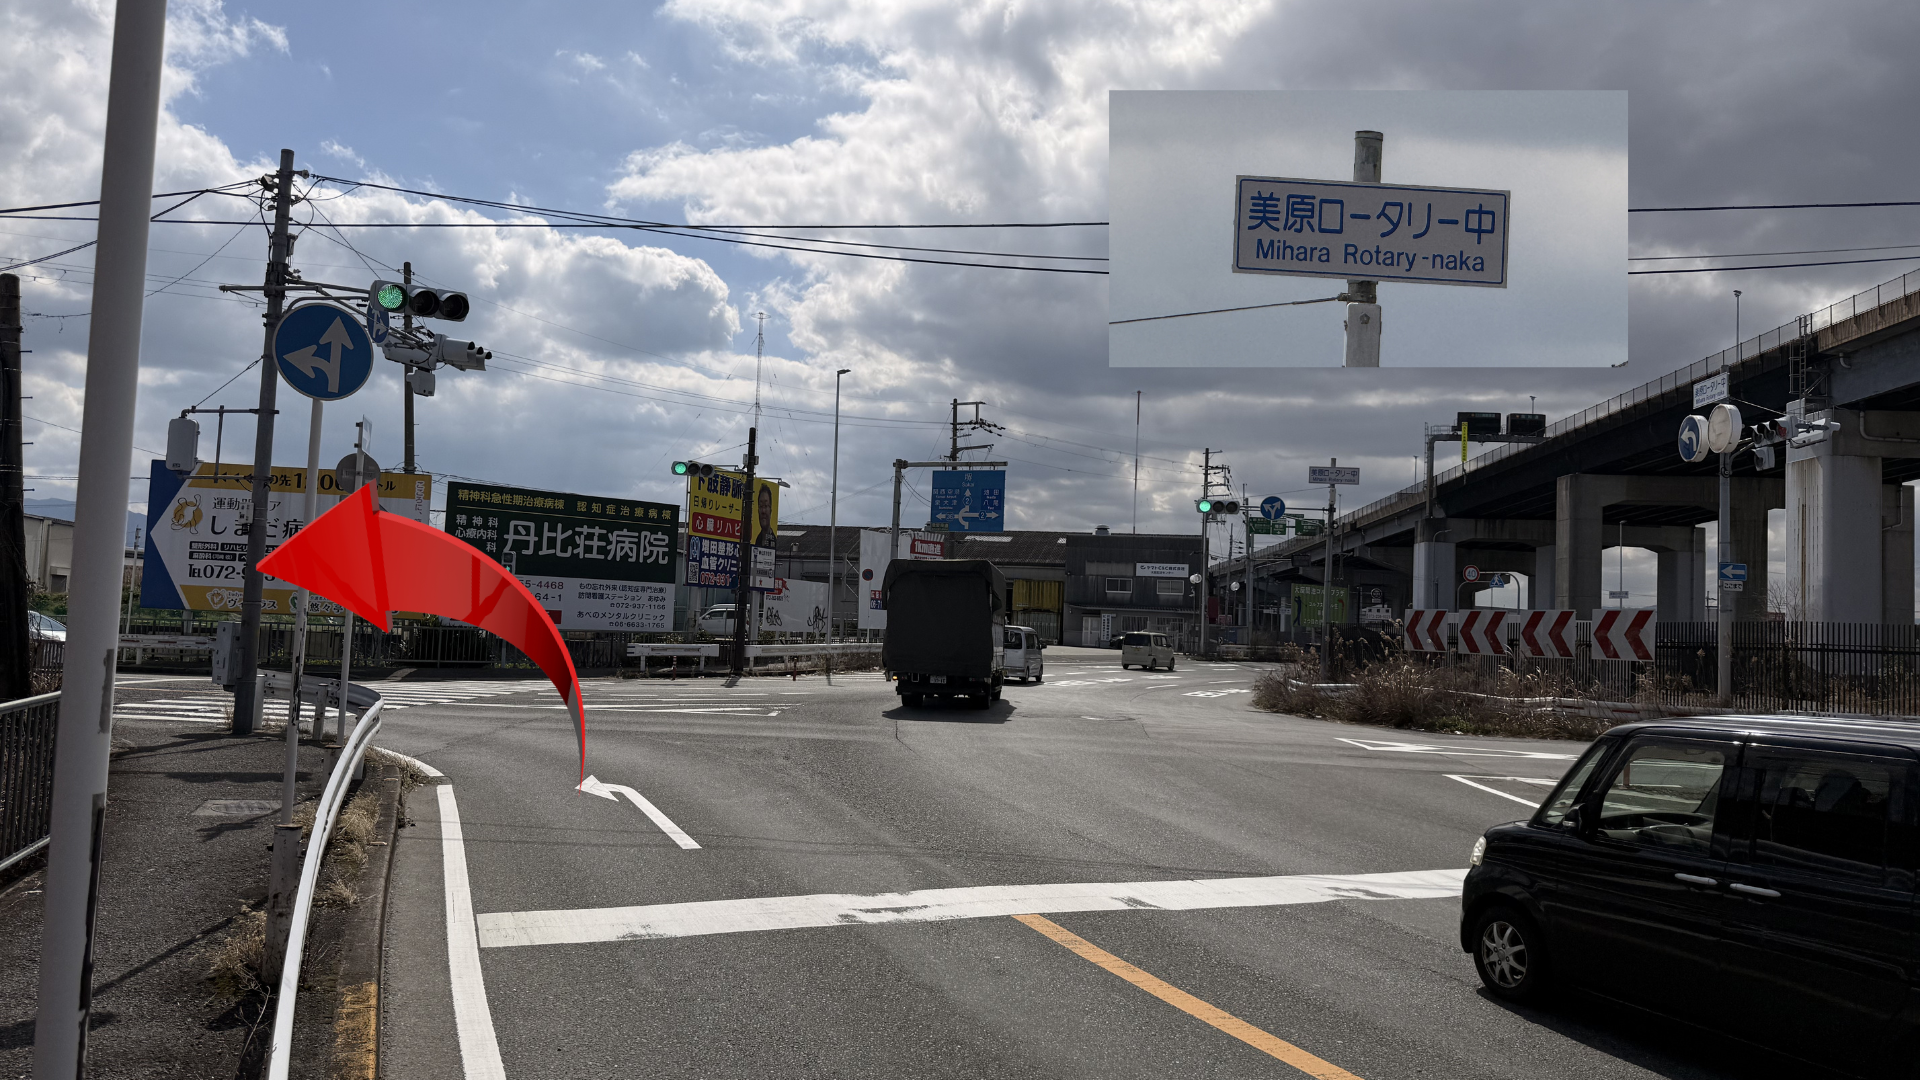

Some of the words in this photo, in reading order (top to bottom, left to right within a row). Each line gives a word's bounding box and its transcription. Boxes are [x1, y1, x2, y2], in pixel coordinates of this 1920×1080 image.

[1247, 190, 1496, 245] 美原ロータリー中
[1255, 238, 1331, 264] Mihara
[1311, 468, 1358, 478] 美原ロータリー中
[697, 473, 744, 500] 下肢静脈
[212, 496, 281, 511] 運動ア
[457, 489, 565, 510] 精神科急性期治療病棟
[576, 500, 672, 520] 認知症治療病棟
[965, 497, 970, 505] 2
[455, 514, 499, 528] 精神科
[695, 515, 741, 536] 心臓リハビ
[454, 526, 498, 540] 心療内科
[485, 541, 497, 553] 科
[503, 520, 669, 564] 丹比荘病院
[701, 555, 739, 572] 血管クリニ
[1466, 569, 1477, 578] 40
[520, 579, 564, 590] 55-4468
[531, 592, 562, 602] 64-1
[576, 611, 665, 621] あべのメンタルクリニック
